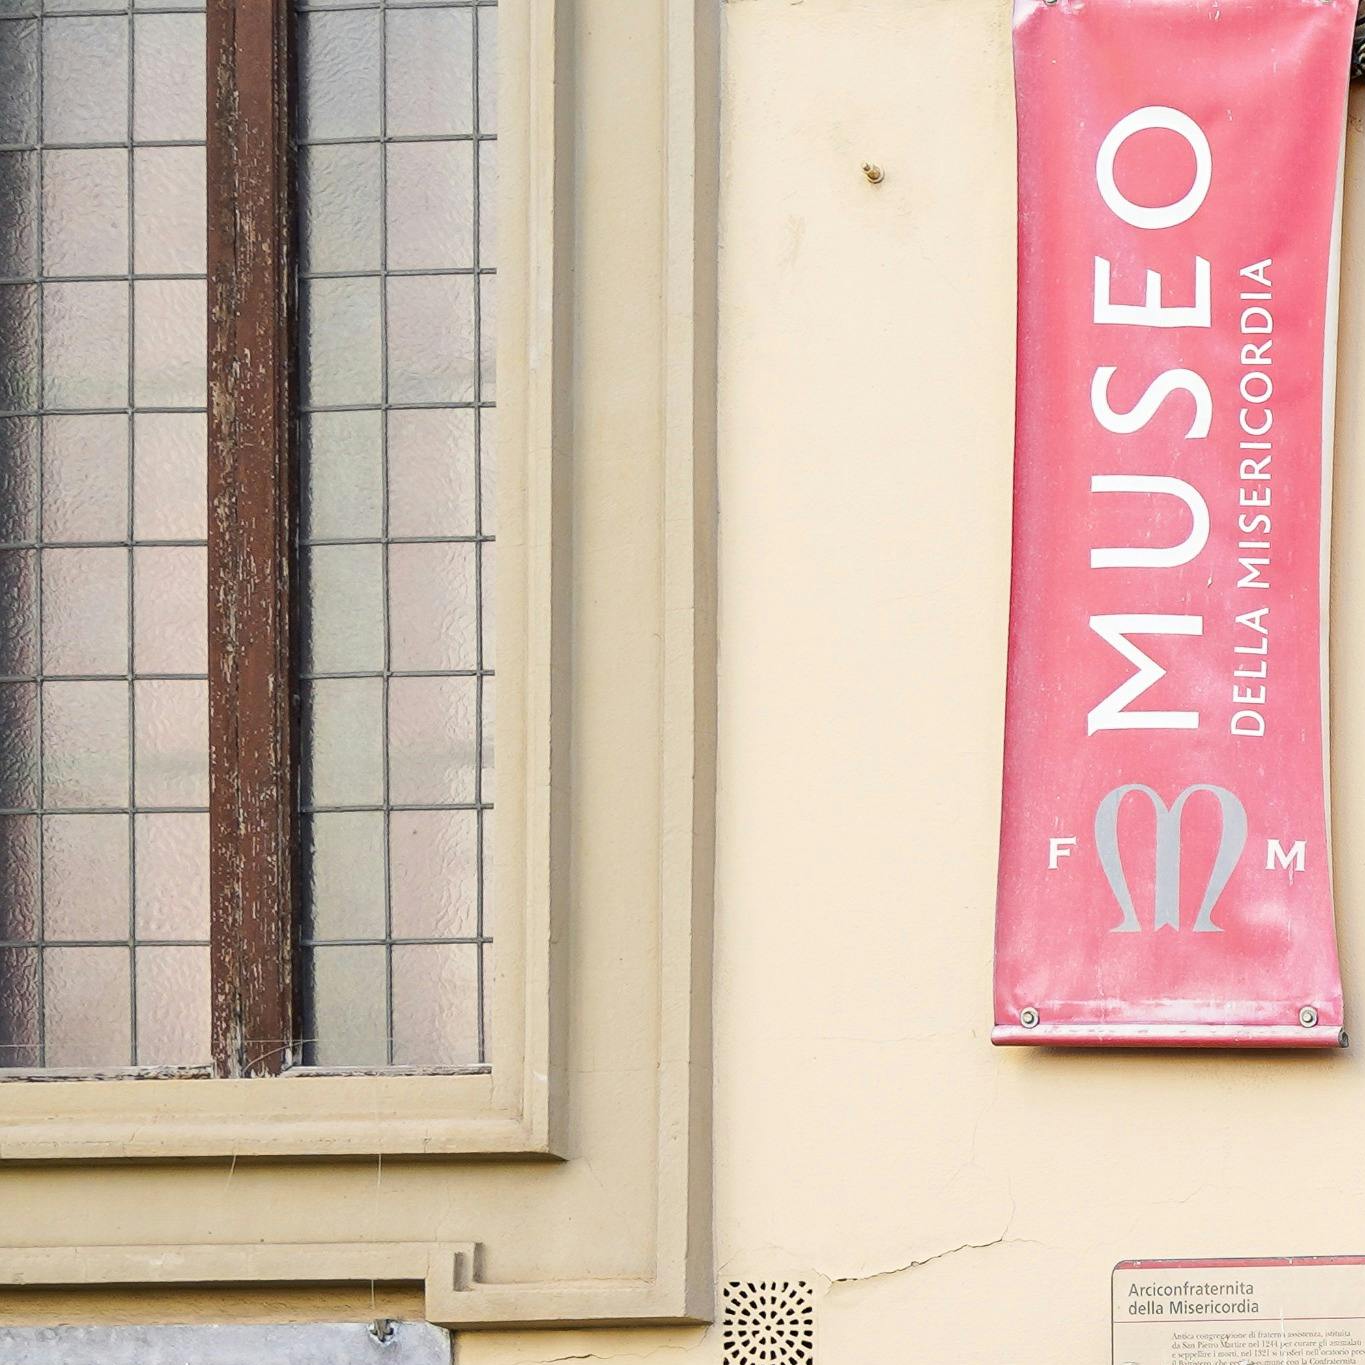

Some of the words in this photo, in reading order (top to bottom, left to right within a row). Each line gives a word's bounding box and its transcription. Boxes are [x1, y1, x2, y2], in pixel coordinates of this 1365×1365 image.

[1085, 103, 1214, 736] MUSEO
[1236, 257, 1272, 590] MISERICORDIA
[1230, 606, 1270, 738] DELLA
[1048, 836, 1077, 869] F
[1266, 840, 1306, 872] M
[1128, 1281, 1254, 1297] Arciconfraternita
[1128, 1301, 1163, 1315] della
[1169, 1298, 1259, 1314] Misericordia
